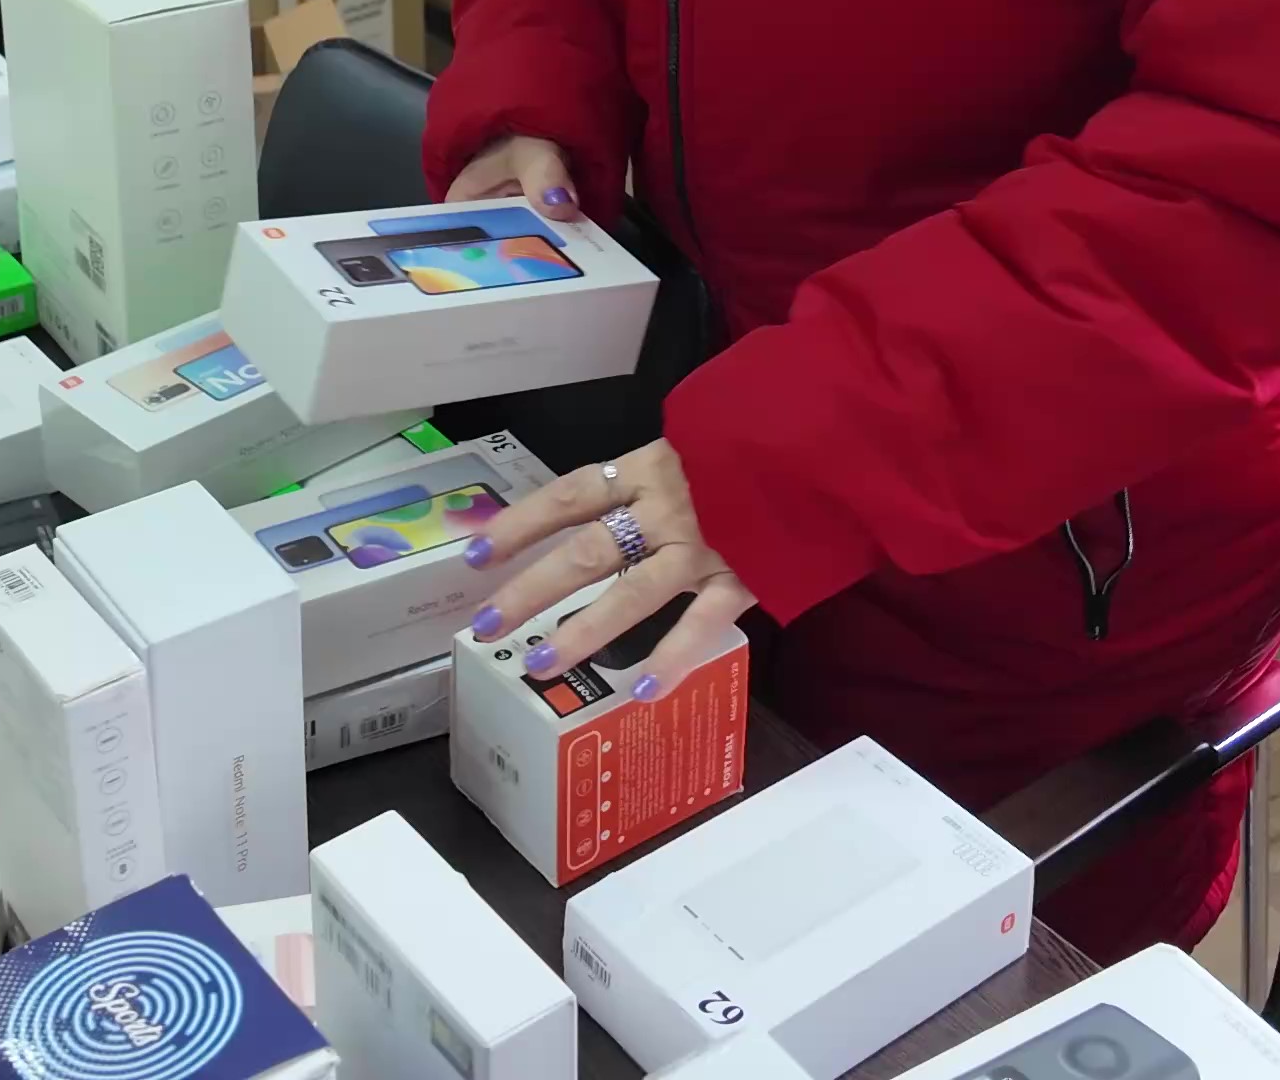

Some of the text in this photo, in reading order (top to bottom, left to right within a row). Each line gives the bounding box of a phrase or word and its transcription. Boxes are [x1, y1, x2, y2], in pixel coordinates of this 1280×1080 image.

[318, 286, 356, 308] 22
[482, 434, 517, 453] 36
[233, 754, 246, 793] Redmi
[235, 795, 246, 827] Note
[237, 849, 249, 873] Pro
[89, 982, 163, 1047] Sports
[698, 990, 744, 1025] 62
